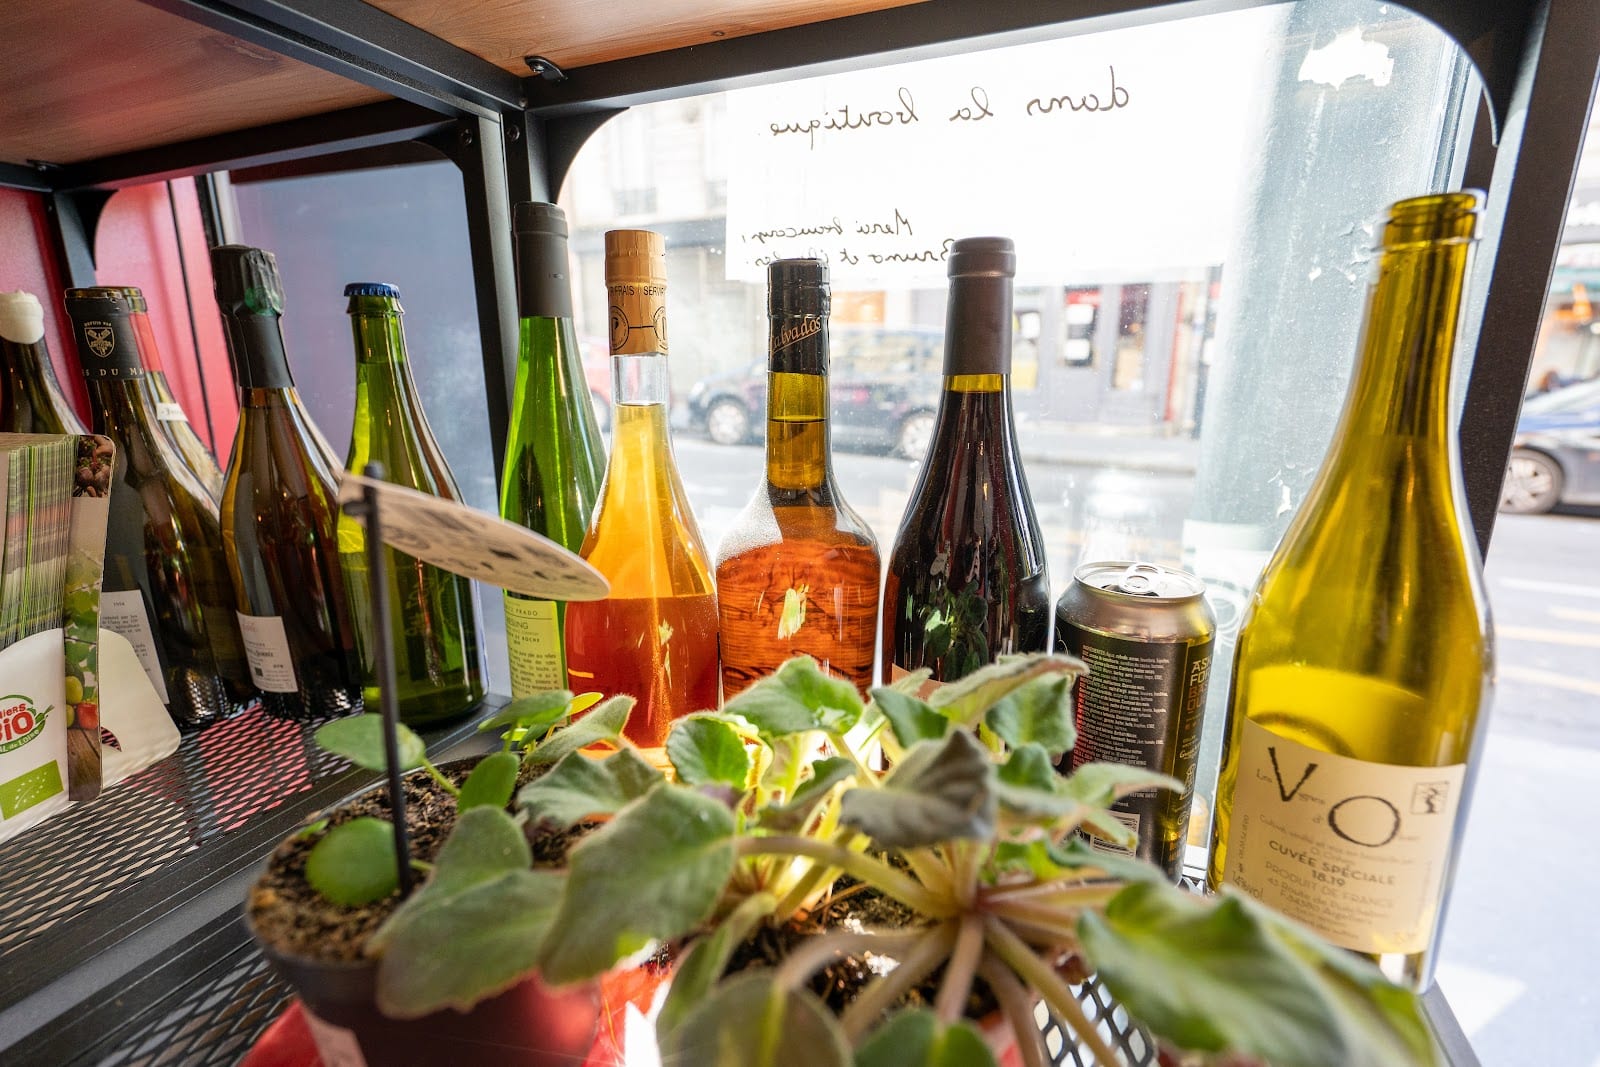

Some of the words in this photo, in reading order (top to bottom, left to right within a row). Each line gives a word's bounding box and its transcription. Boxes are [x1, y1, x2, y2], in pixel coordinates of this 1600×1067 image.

[99, 368, 119, 377] DU
[1266, 860, 1319, 891] PRODUIT
[1322, 886, 1341, 899] DE
[1268, 839, 1318, 867] CUVÉE
[1322, 862, 1397, 886] SPÉCIALE
